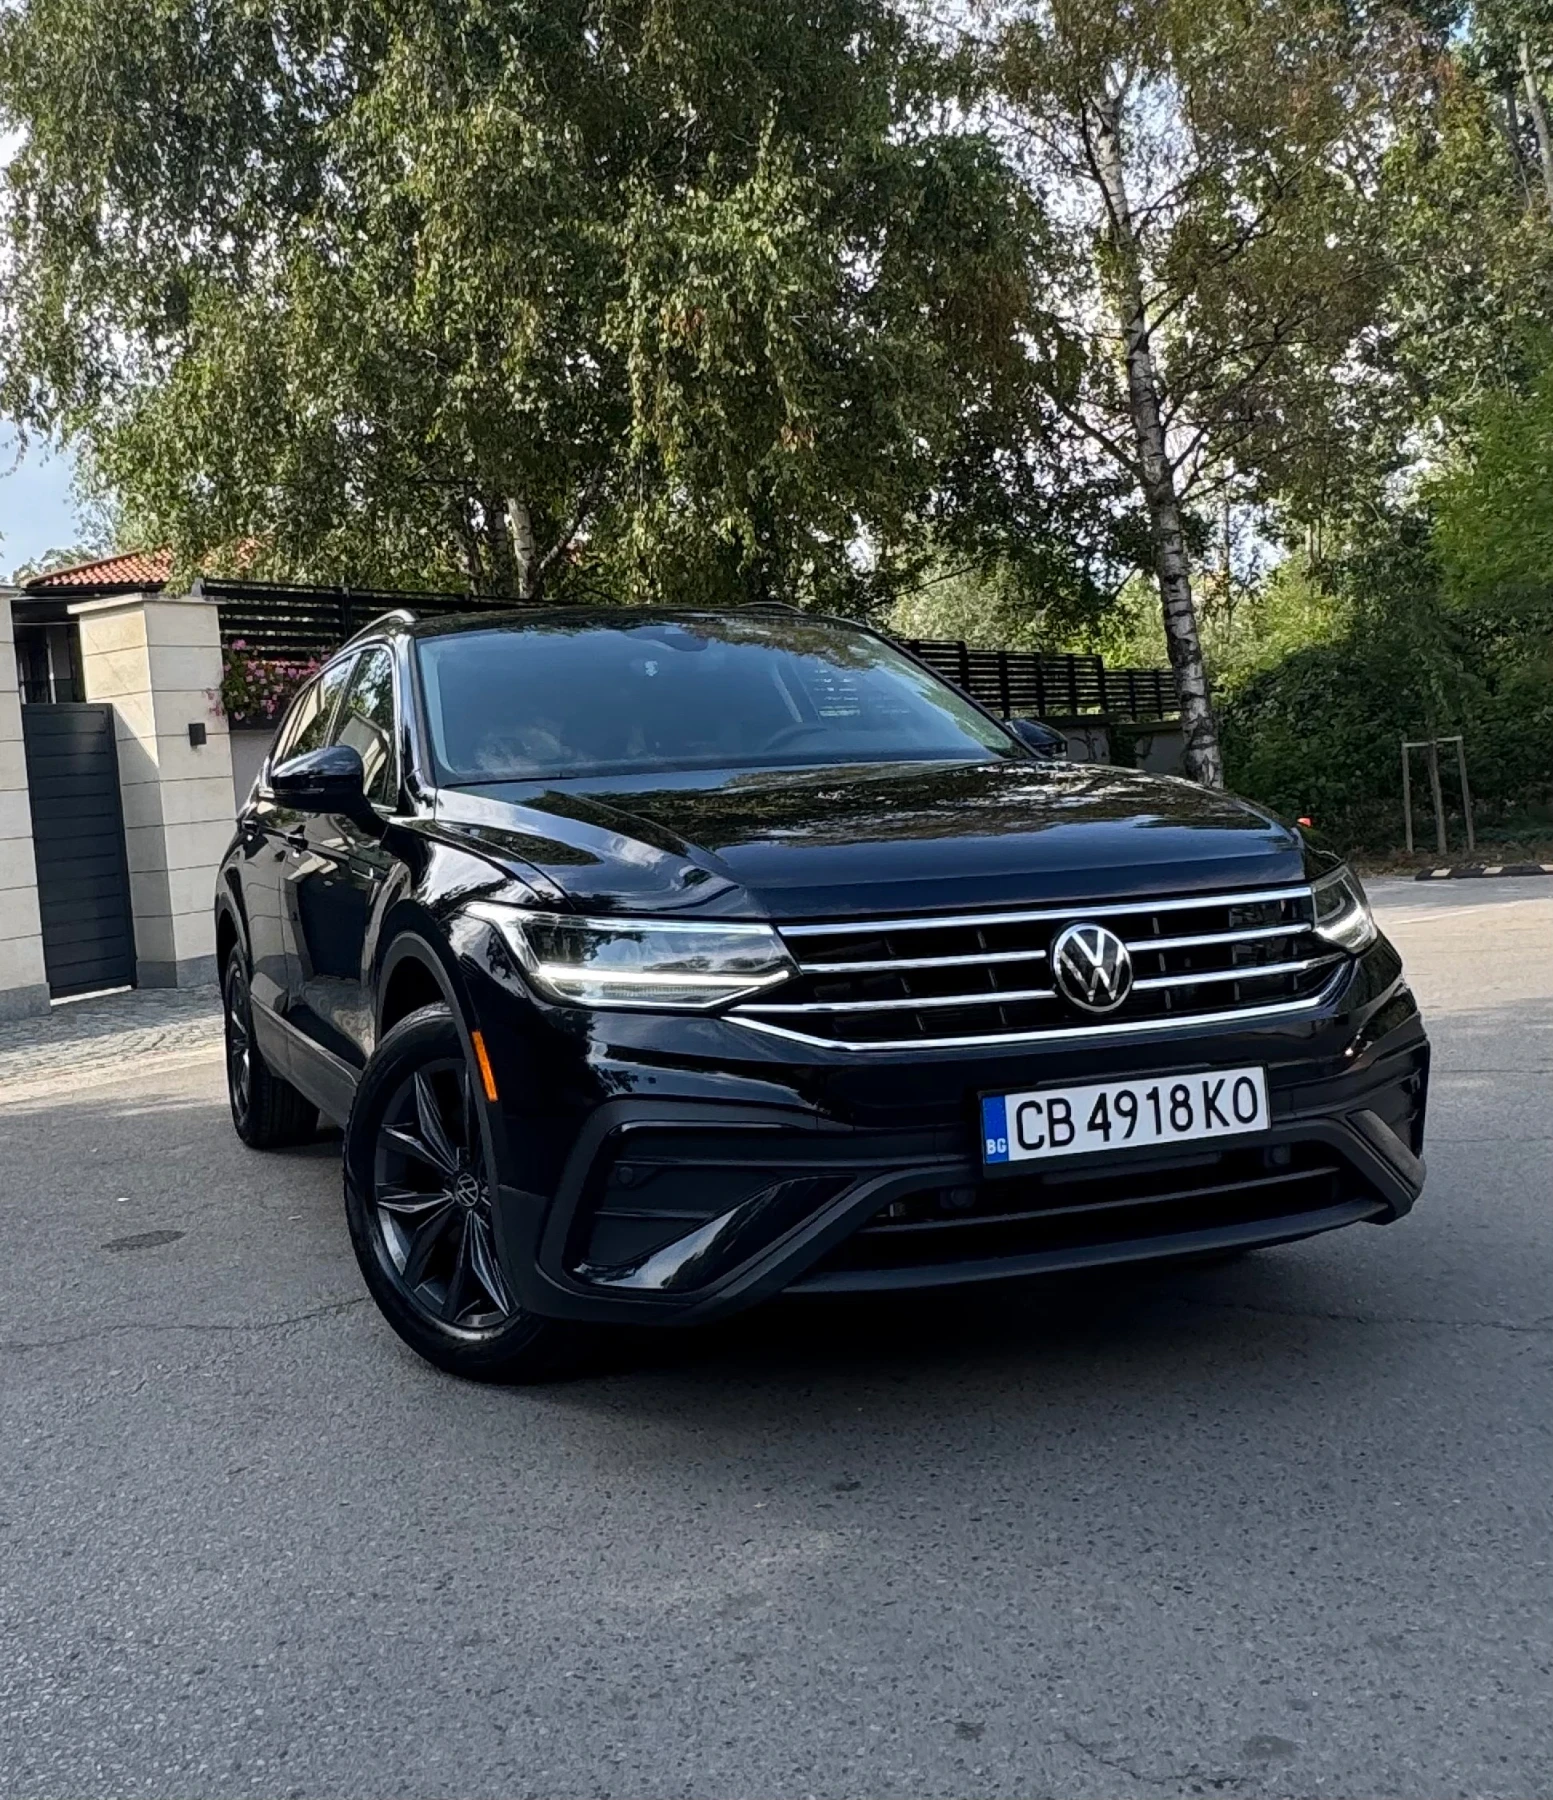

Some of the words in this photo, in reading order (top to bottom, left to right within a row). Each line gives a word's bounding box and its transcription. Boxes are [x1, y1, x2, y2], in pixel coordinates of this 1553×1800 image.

[1056, 924, 1131, 1009] VW
[985, 1138, 1007, 1155] BG
[1015, 1097, 1075, 1151] CB
[1086, 1083, 1194, 1143] 4918
[1202, 1076, 1259, 1130] KO
